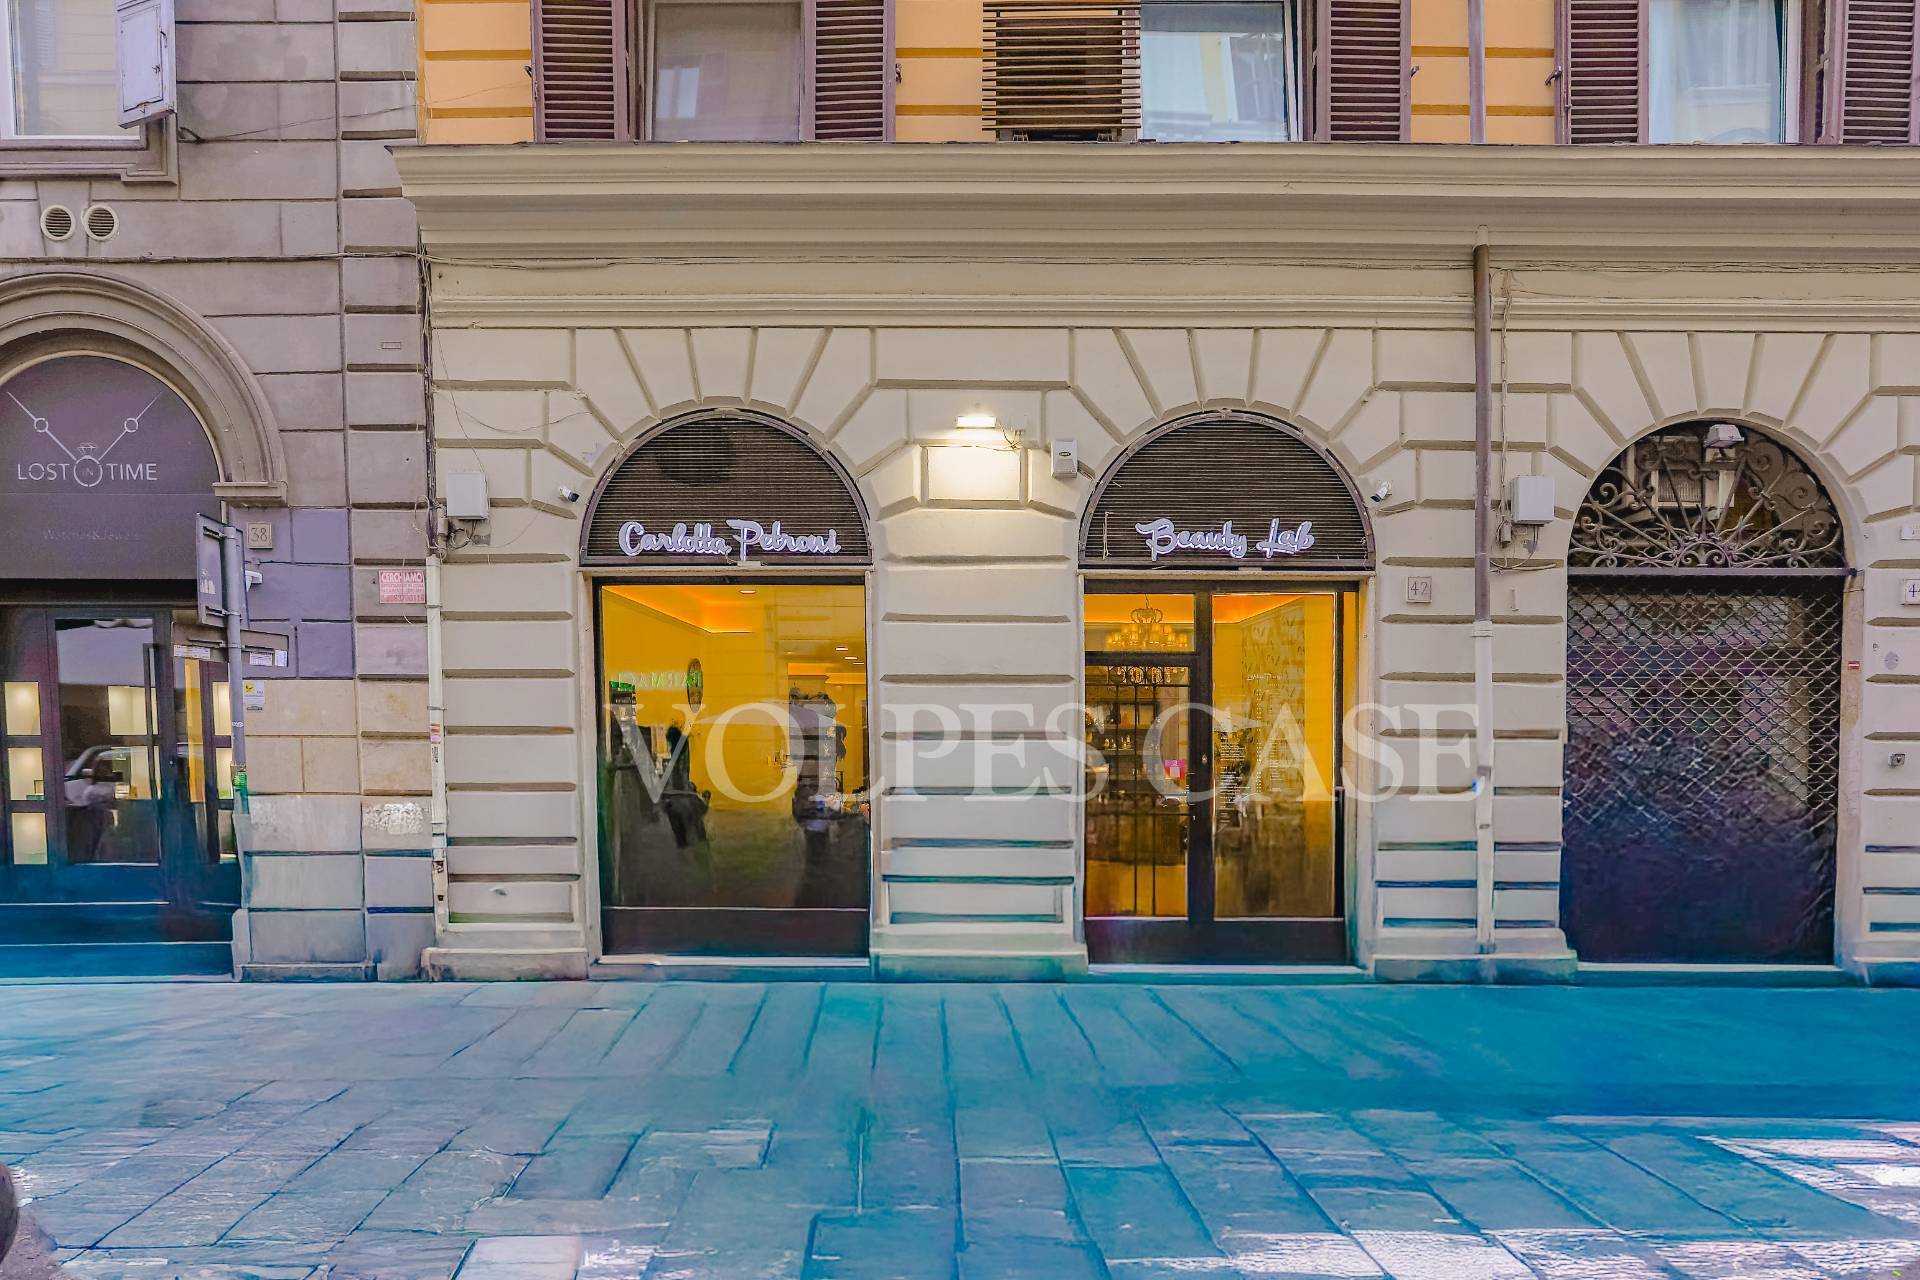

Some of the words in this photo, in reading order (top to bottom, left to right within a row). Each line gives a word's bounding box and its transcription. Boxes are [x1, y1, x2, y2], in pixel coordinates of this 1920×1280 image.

[17, 463, 70, 480] LOST
[106, 463, 158, 481] TIME
[250, 527, 269, 542] 38
[618, 521, 733, 557] Carlotta
[726, 519, 842, 561] Petroni
[1134, 517, 1248, 562] Beauty
[1255, 517, 1316, 559] Lab
[381, 572, 423, 583] CERCHIAMO
[1409, 581, 1429, 597] 42
